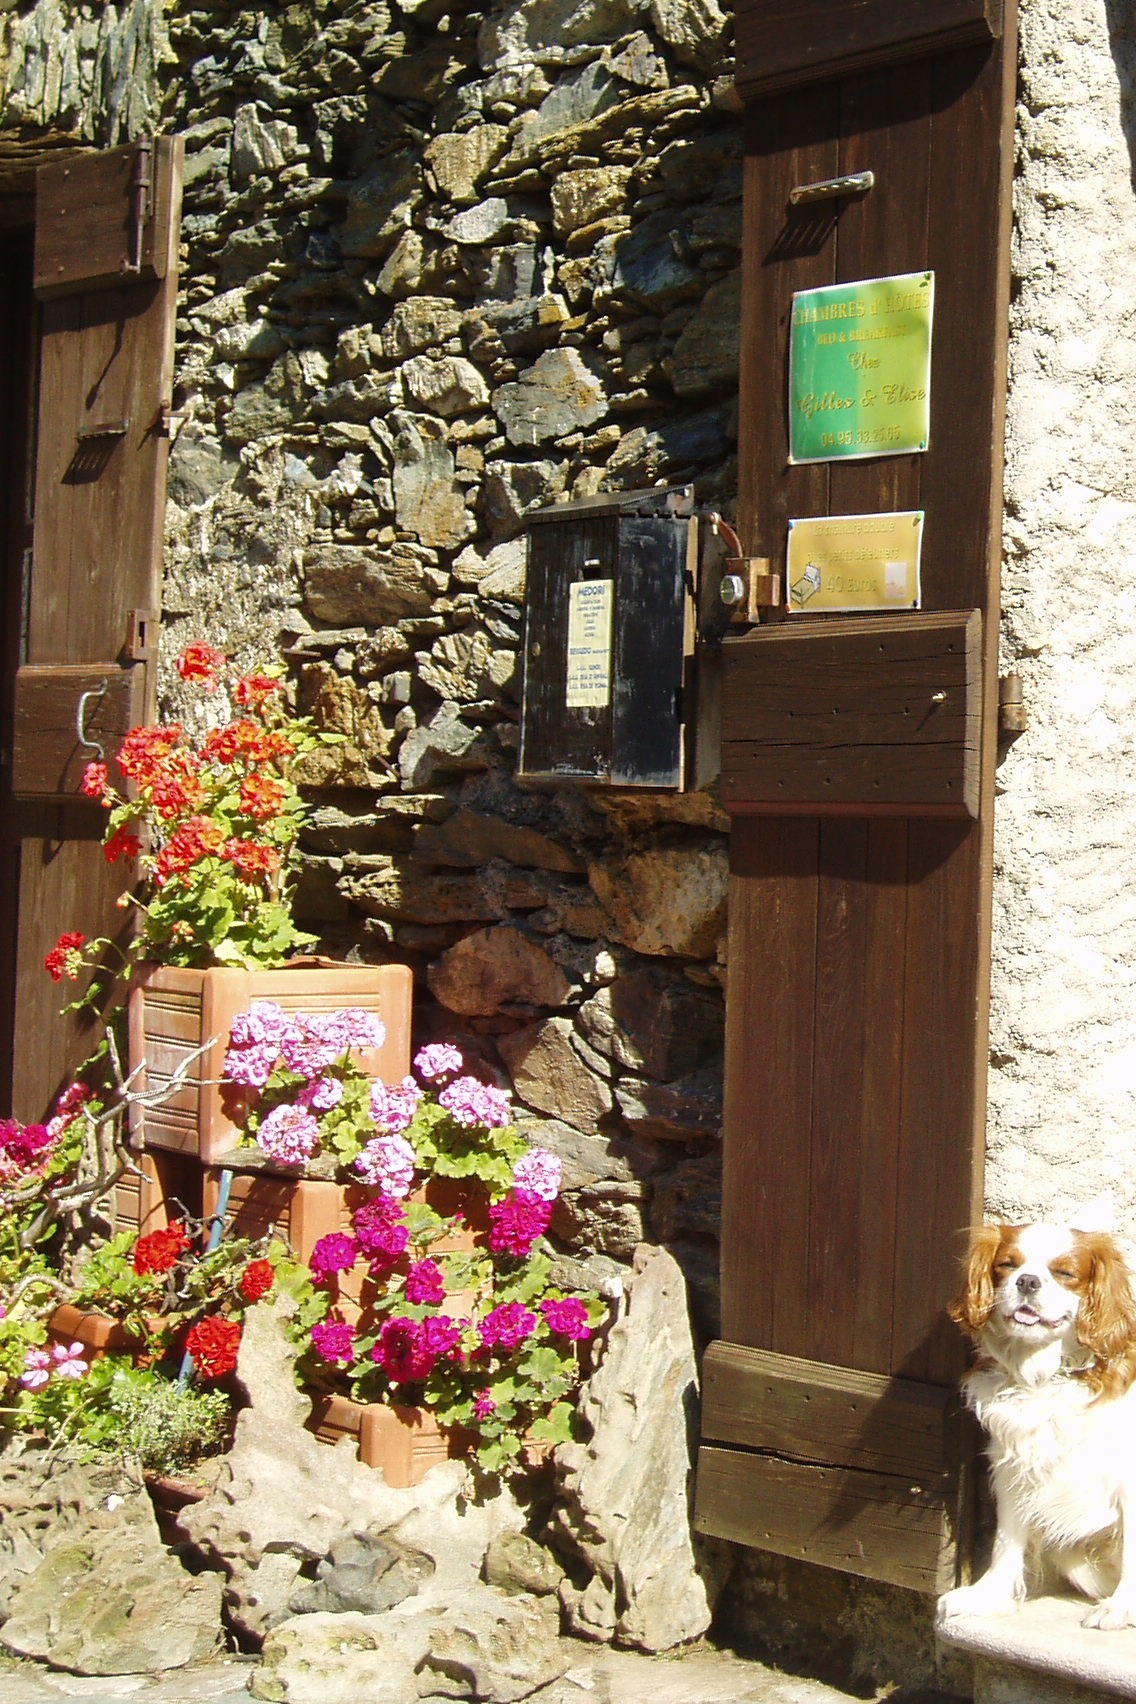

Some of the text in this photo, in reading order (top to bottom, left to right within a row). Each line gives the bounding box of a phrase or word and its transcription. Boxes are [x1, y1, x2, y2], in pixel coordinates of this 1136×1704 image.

[799, 383, 927, 420] Gilles & Elise
